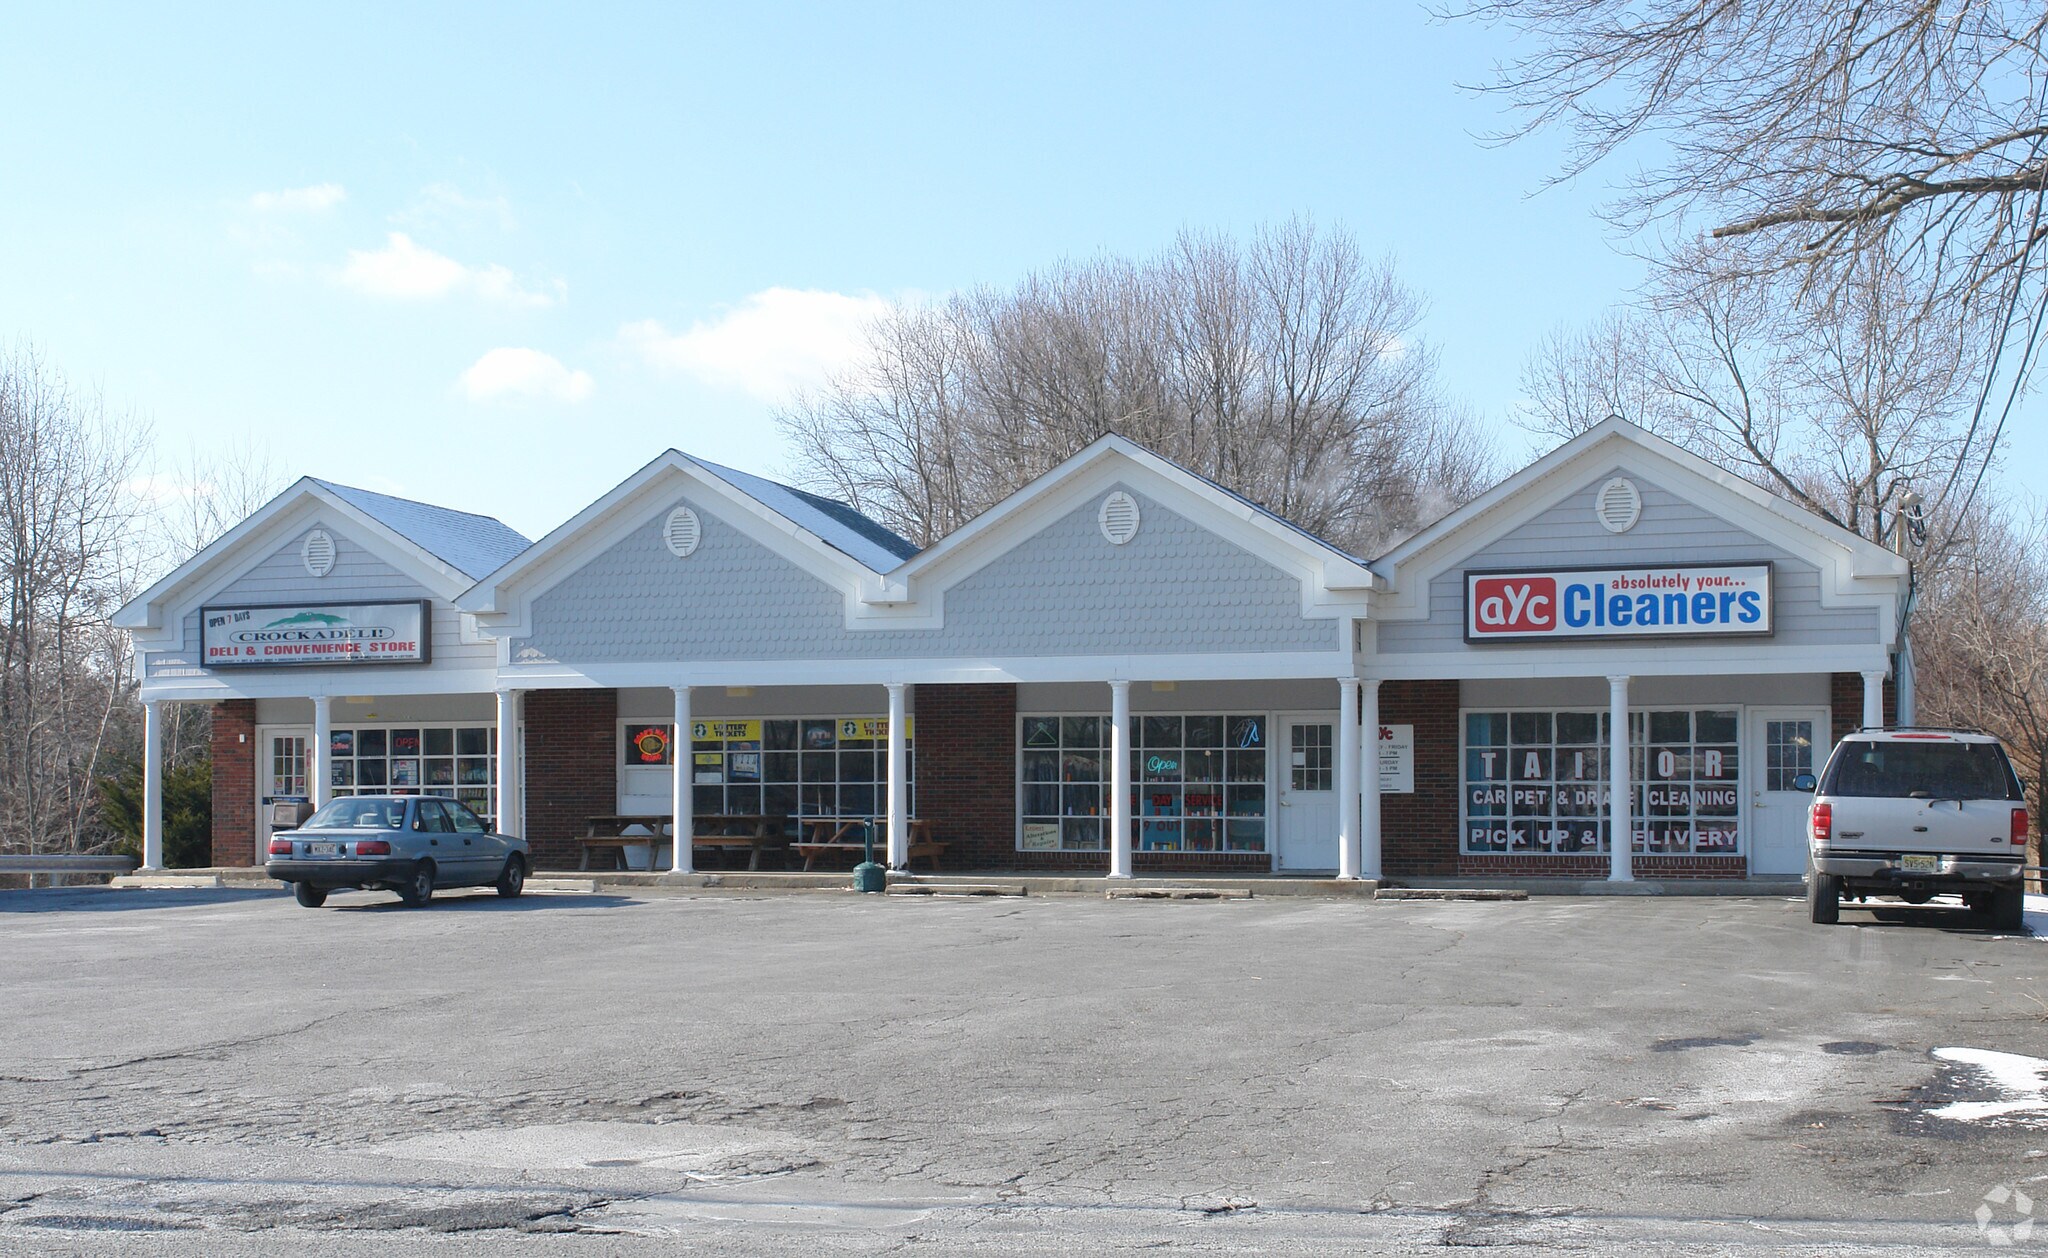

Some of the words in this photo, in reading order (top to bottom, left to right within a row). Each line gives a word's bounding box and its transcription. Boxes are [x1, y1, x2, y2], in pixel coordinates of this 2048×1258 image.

[1612, 573, 1690, 591] absolutely
[1564, 583, 1761, 628] Cleaners
[209, 616, 226, 628] OPEN
[227, 615, 232, 624] 7
[234, 611, 251, 622] DAYS
[210, 647, 239, 657] DELI
[246, 646, 256, 656] &
[264, 642, 361, 656] CONVENIENCE
[369, 641, 416, 653] STORE
[1147, 755, 1178, 774] Open
[1481, 750, 1723, 779] TAIOR
[1152, 794, 1172, 806] DAY
[1185, 794, 1223, 806] SERVICE
[1473, 789, 1547, 806] CARPET
[1557, 790, 1569, 806] &
[1576, 790, 1635, 806] DRA
[1649, 790, 1737, 806] CLEANING
[1156, 820, 1181, 832] OUT
[1472, 829, 1526, 844] PICK
[1539, 829, 1570, 845] UP
[1581, 830, 1597, 845] &
[1632, 829, 1738, 847] ELIVERY
